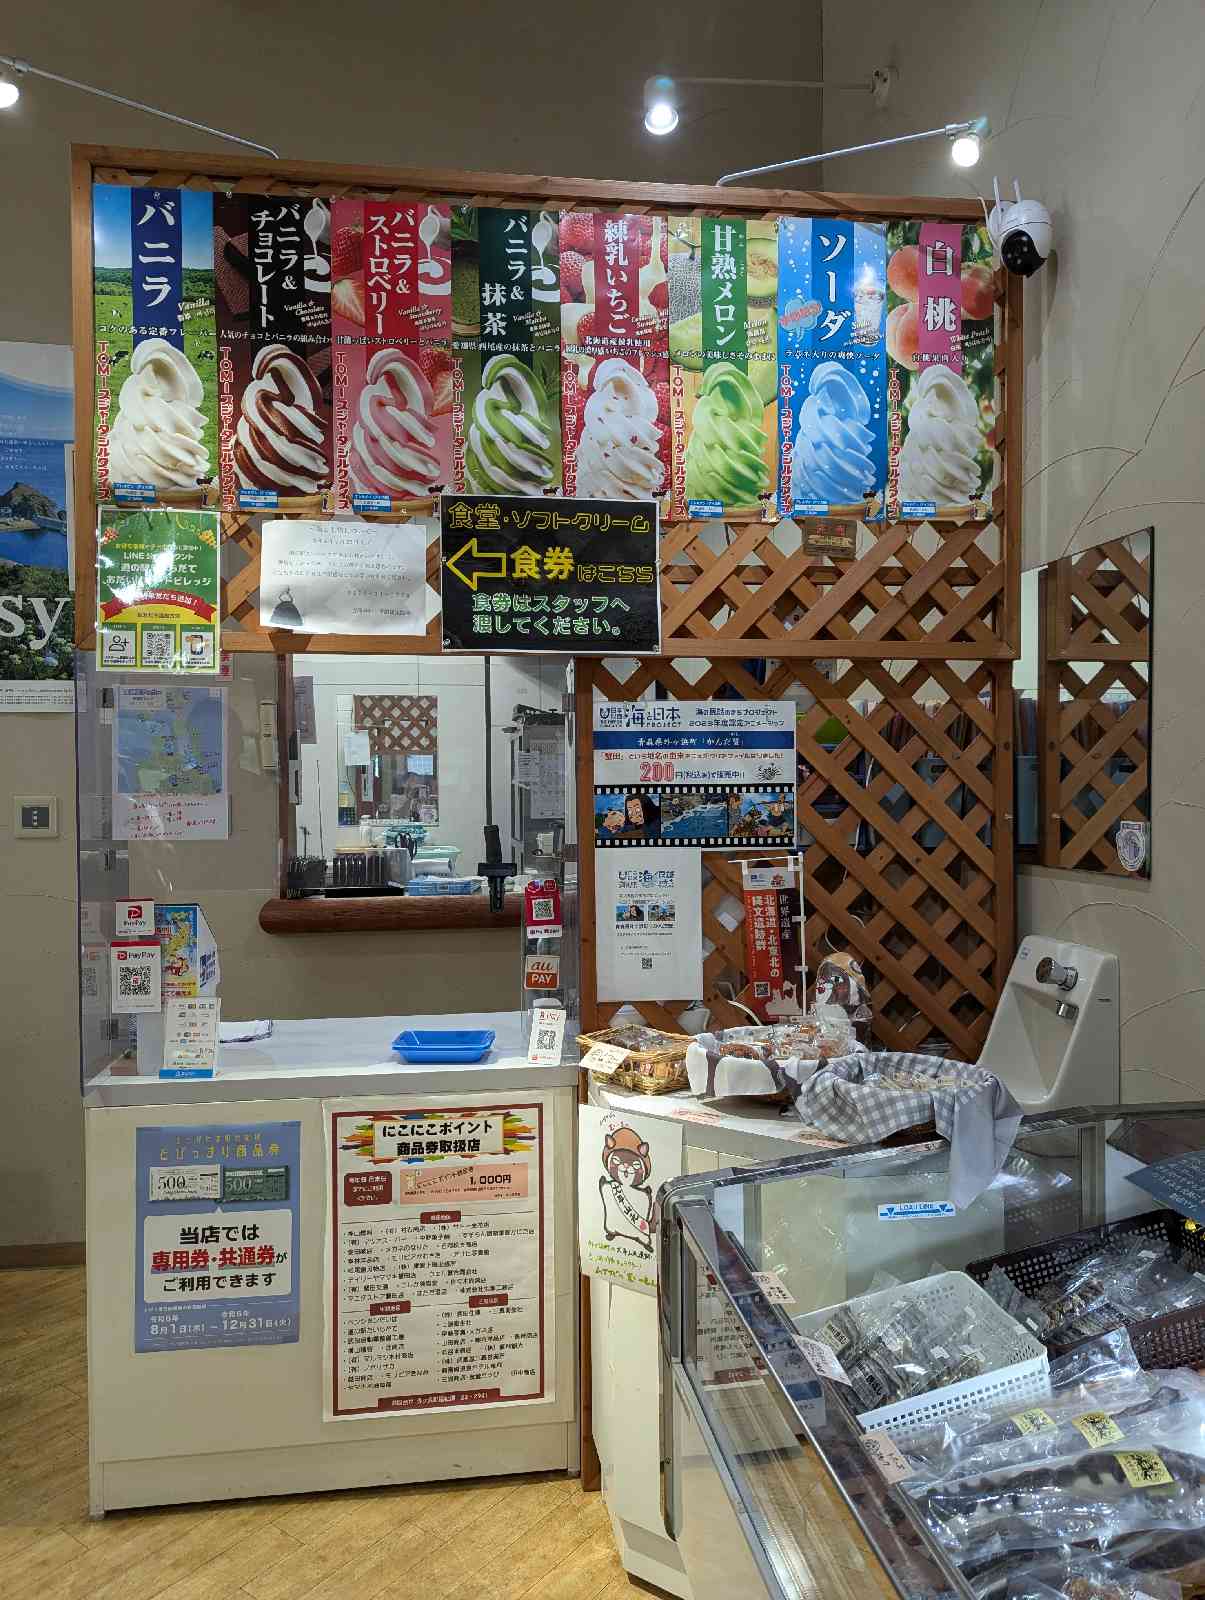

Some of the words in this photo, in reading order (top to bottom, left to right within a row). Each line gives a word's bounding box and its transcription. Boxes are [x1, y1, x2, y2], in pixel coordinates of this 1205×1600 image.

[136, 201, 176, 308] バニラ
[250, 209, 274, 329] チョコレート
[368, 214, 391, 335] ストロベリー
[604, 219, 629, 334] 練乳いちご
[710, 223, 738, 347] 甘熟メロン
[816, 233, 851, 342] ソーダ
[923, 240, 958, 333] 白桃
[481, 282, 507, 337] 抹茶
[448, 501, 650, 532] 食堂・ソフトクリーム
[472, 592, 631, 613] 食券はスタッフへ
[128, 951, 155, 960] PayPay
[531, 974, 553, 985] PAY
[382, 1119, 493, 1138] にこにこポイント
[397, 1137, 481, 1157] 商品券取扱店
[179, 1223, 260, 1245] 当店では
[151, 1245, 288, 1272] 専用券・共通券が
[163, 1272, 277, 1292] ご利用できます
